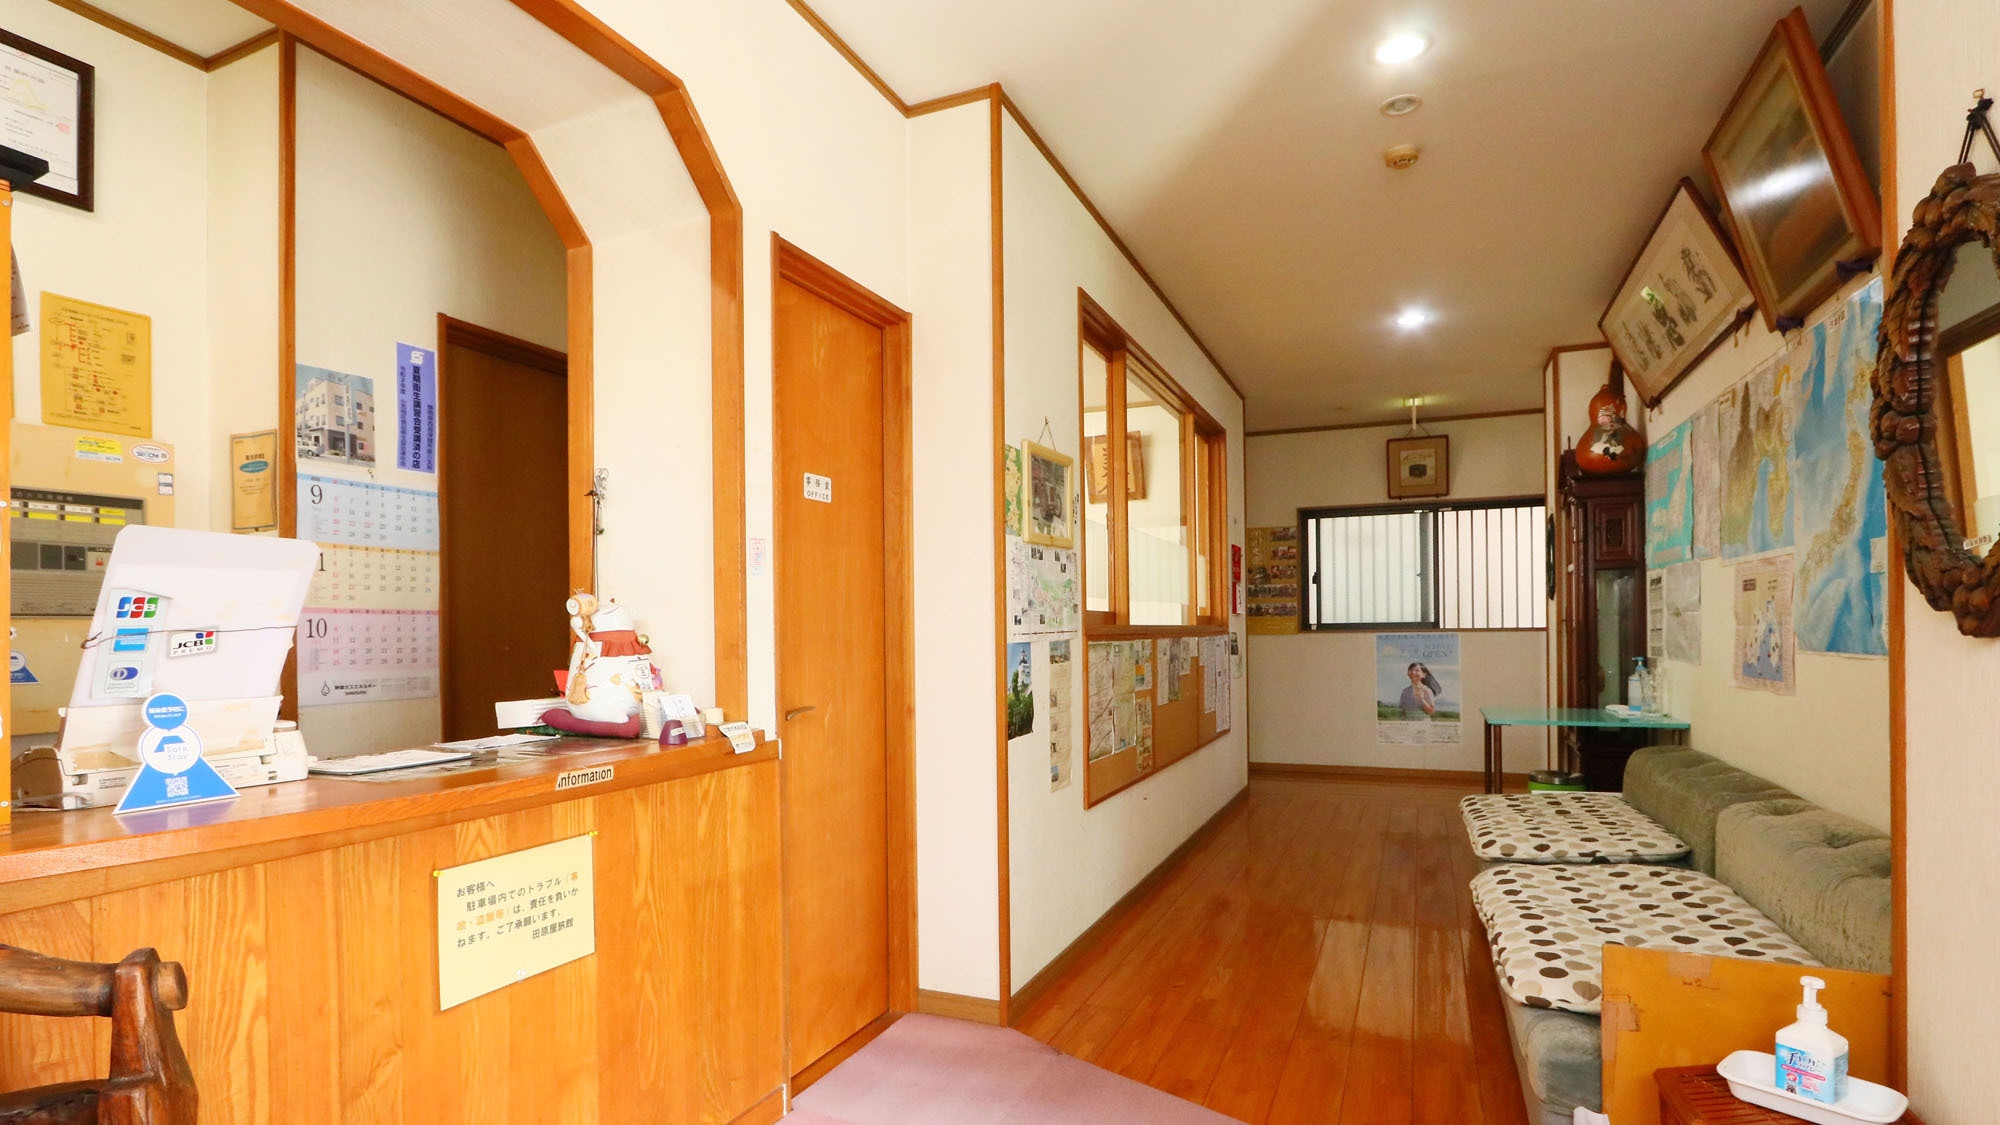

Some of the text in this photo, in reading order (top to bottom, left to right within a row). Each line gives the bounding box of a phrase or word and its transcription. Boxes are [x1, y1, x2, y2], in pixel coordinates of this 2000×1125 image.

[310, 485, 322, 504] 9
[807, 491, 829, 500] OFFICE
[306, 618, 327, 638] 10
[173, 640, 203, 650] JCB
[173, 646, 212, 655] PREMO
[456, 880, 495, 898] お客様へ
[532, 918, 574, 940] 田原屋旅館
